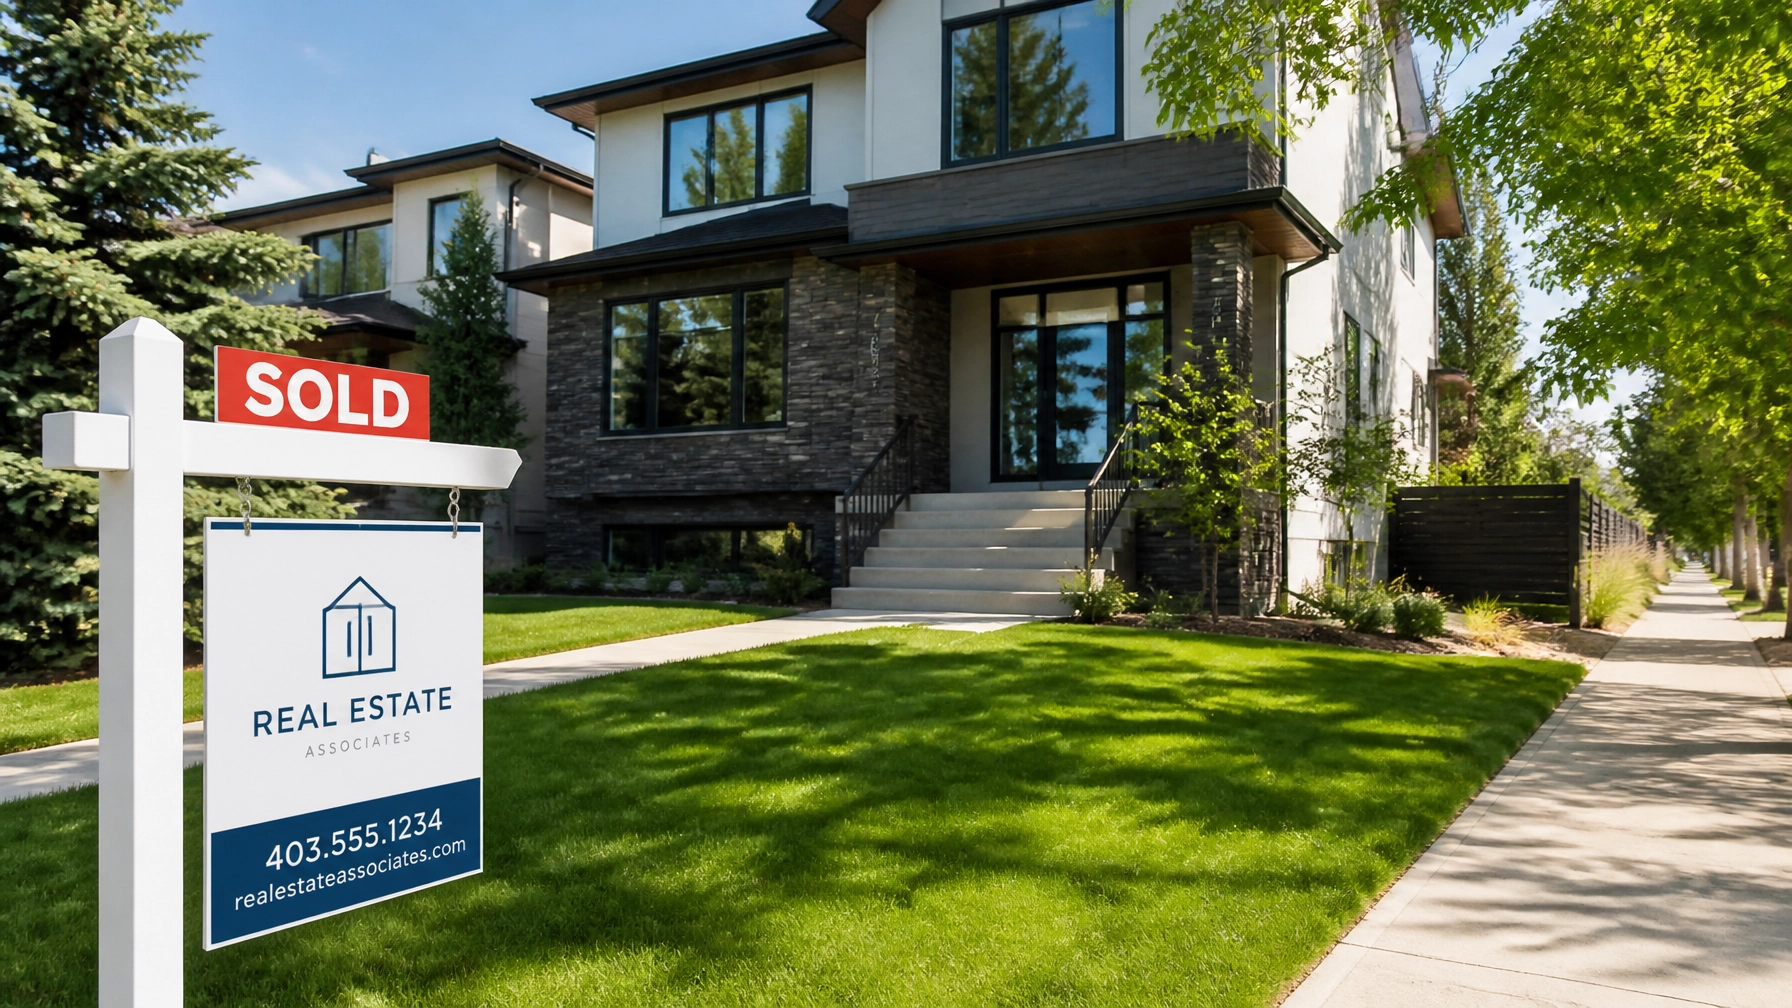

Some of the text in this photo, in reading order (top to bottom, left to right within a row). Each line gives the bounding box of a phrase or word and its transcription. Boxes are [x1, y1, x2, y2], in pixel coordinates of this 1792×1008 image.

[244, 361, 410, 429] SOLD
[253, 686, 452, 738] REAL ESTATE
[305, 730, 411, 758] ASSOCIATES
[265, 807, 443, 871] 403.555.1234
[235, 838, 466, 911] realestateassociates.com
